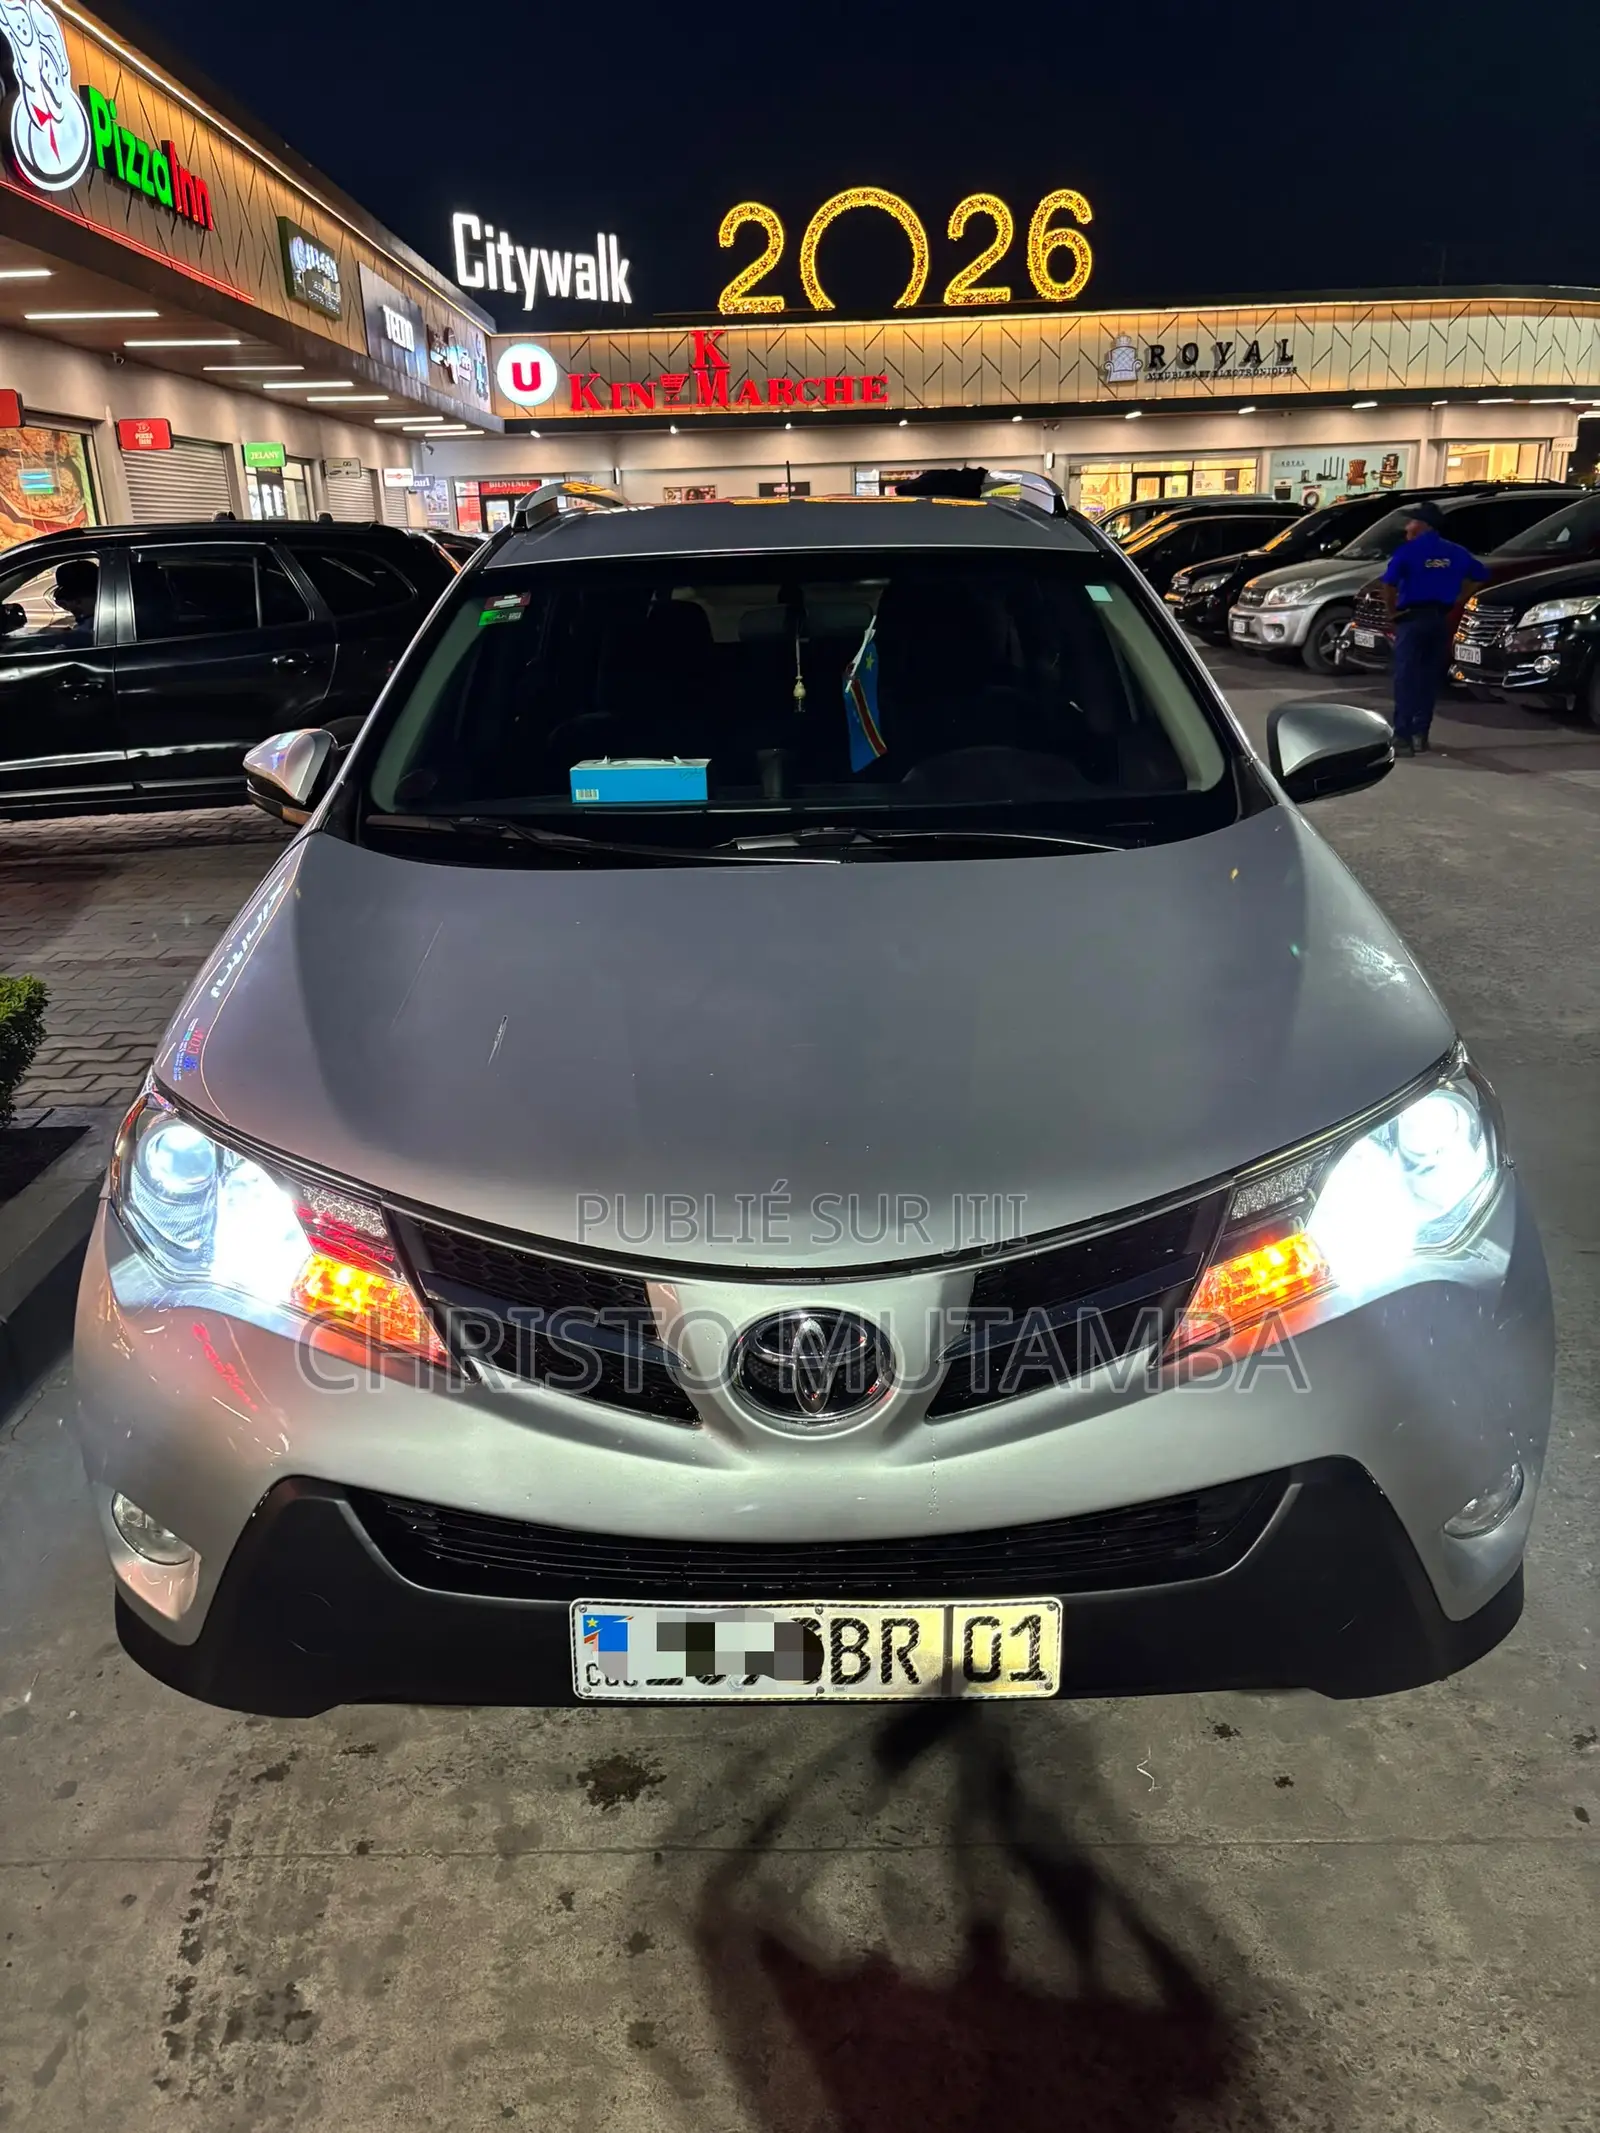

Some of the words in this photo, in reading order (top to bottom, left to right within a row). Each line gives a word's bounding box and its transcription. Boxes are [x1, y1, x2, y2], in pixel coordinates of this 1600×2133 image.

[451, 211, 633, 312] Citywalk
[718, 186, 1093, 315] 2026
[1148, 338, 1294, 369] ROYAL
[512, 361, 542, 391] U
[694, 369, 889, 408] MARCHE
[488, 480, 532, 489] BIENVENUE
[962, 1614, 1048, 1682] 01
